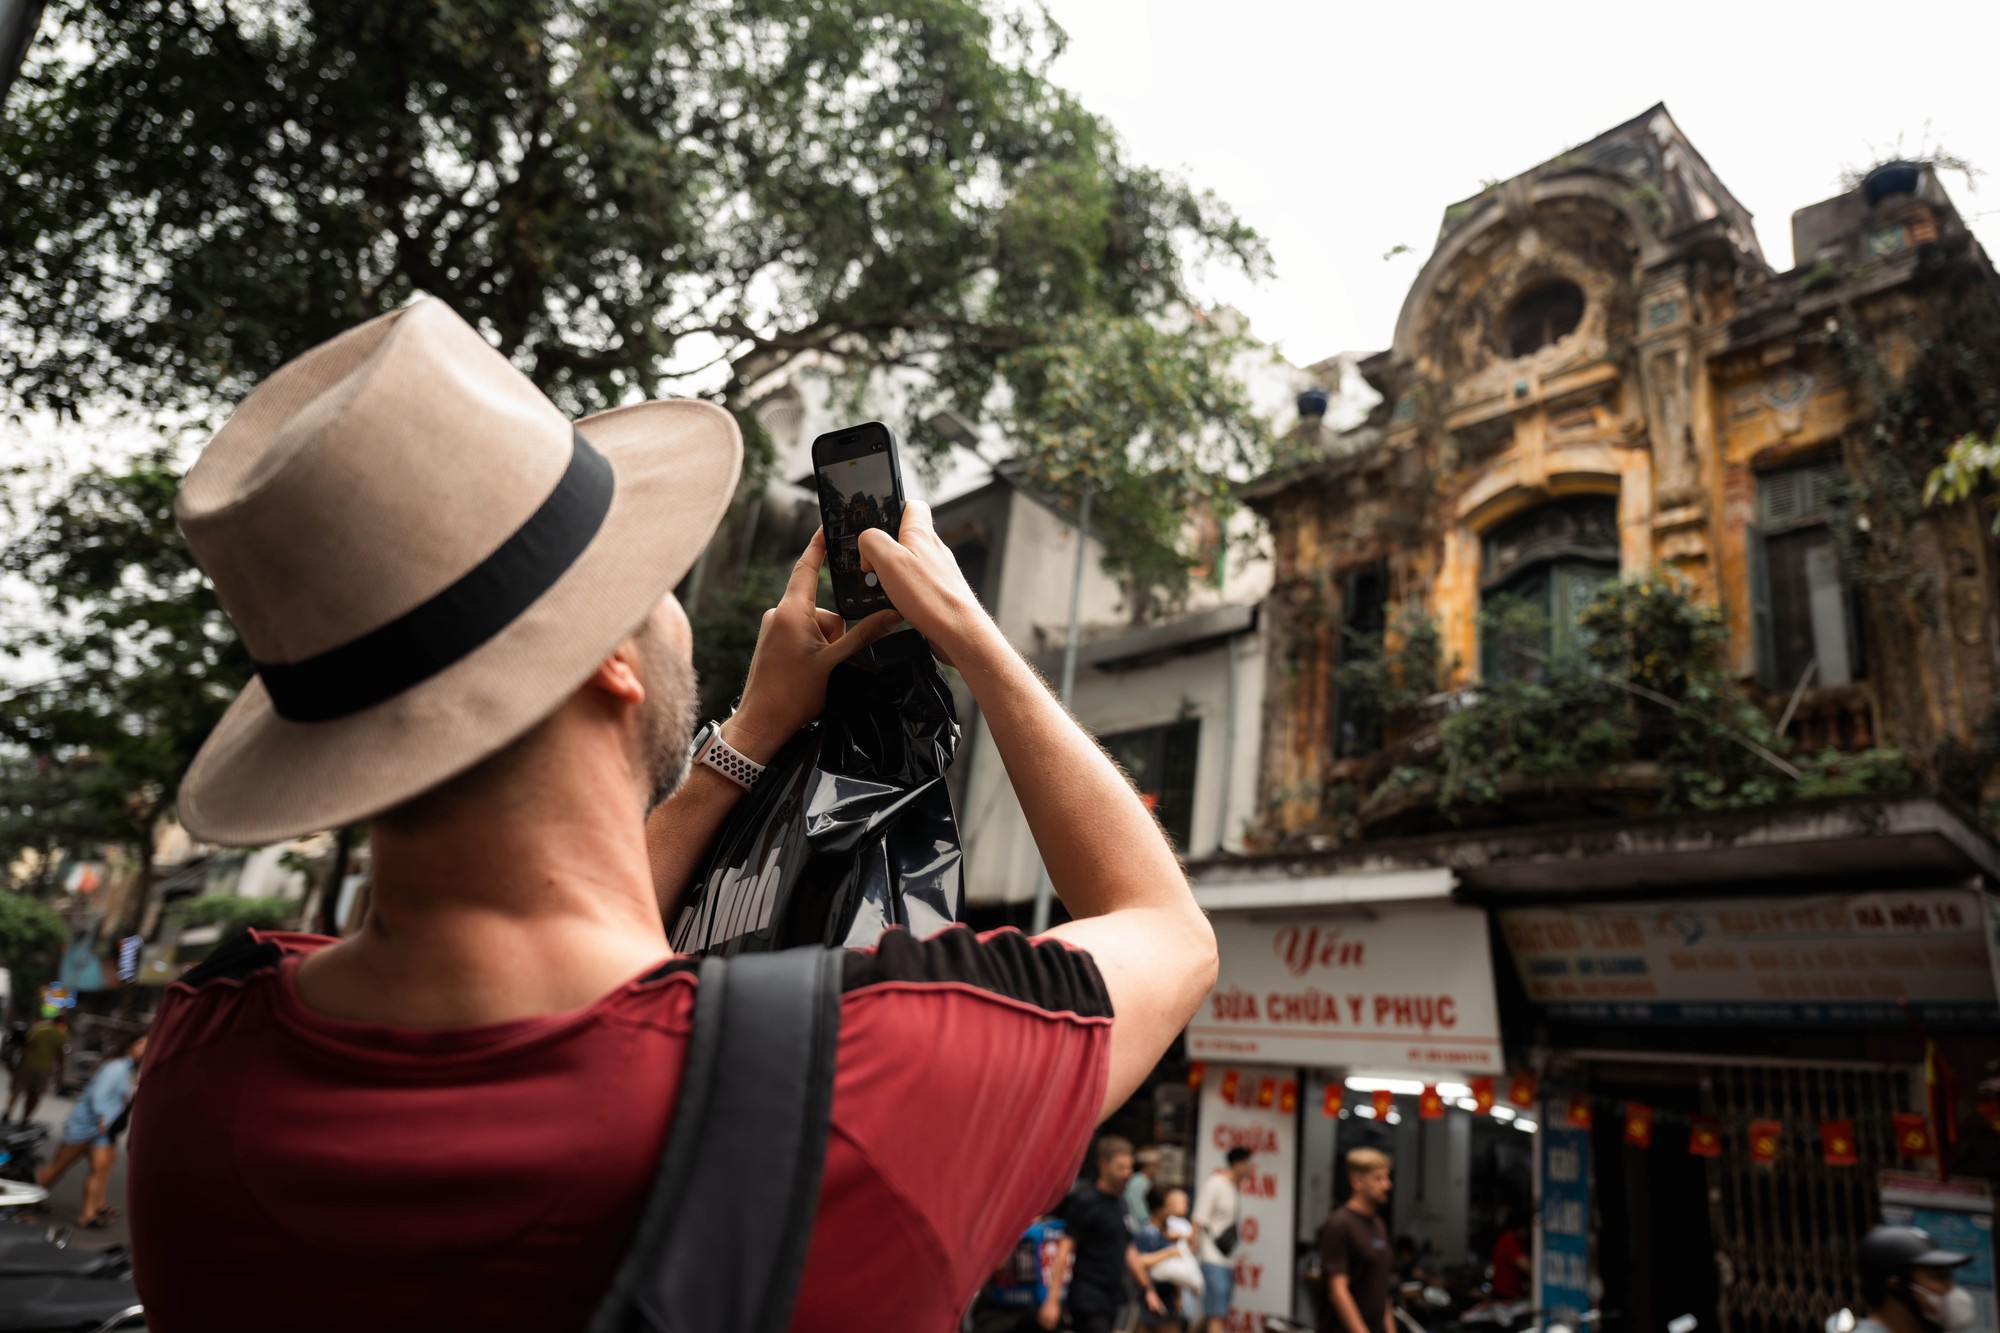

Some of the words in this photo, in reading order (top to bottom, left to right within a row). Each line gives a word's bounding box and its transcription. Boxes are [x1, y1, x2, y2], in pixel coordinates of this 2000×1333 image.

[1273, 925, 1367, 979] Yến
[1345, 994, 1365, 1026] Y
[1374, 995, 1457, 1035] PHỤC
